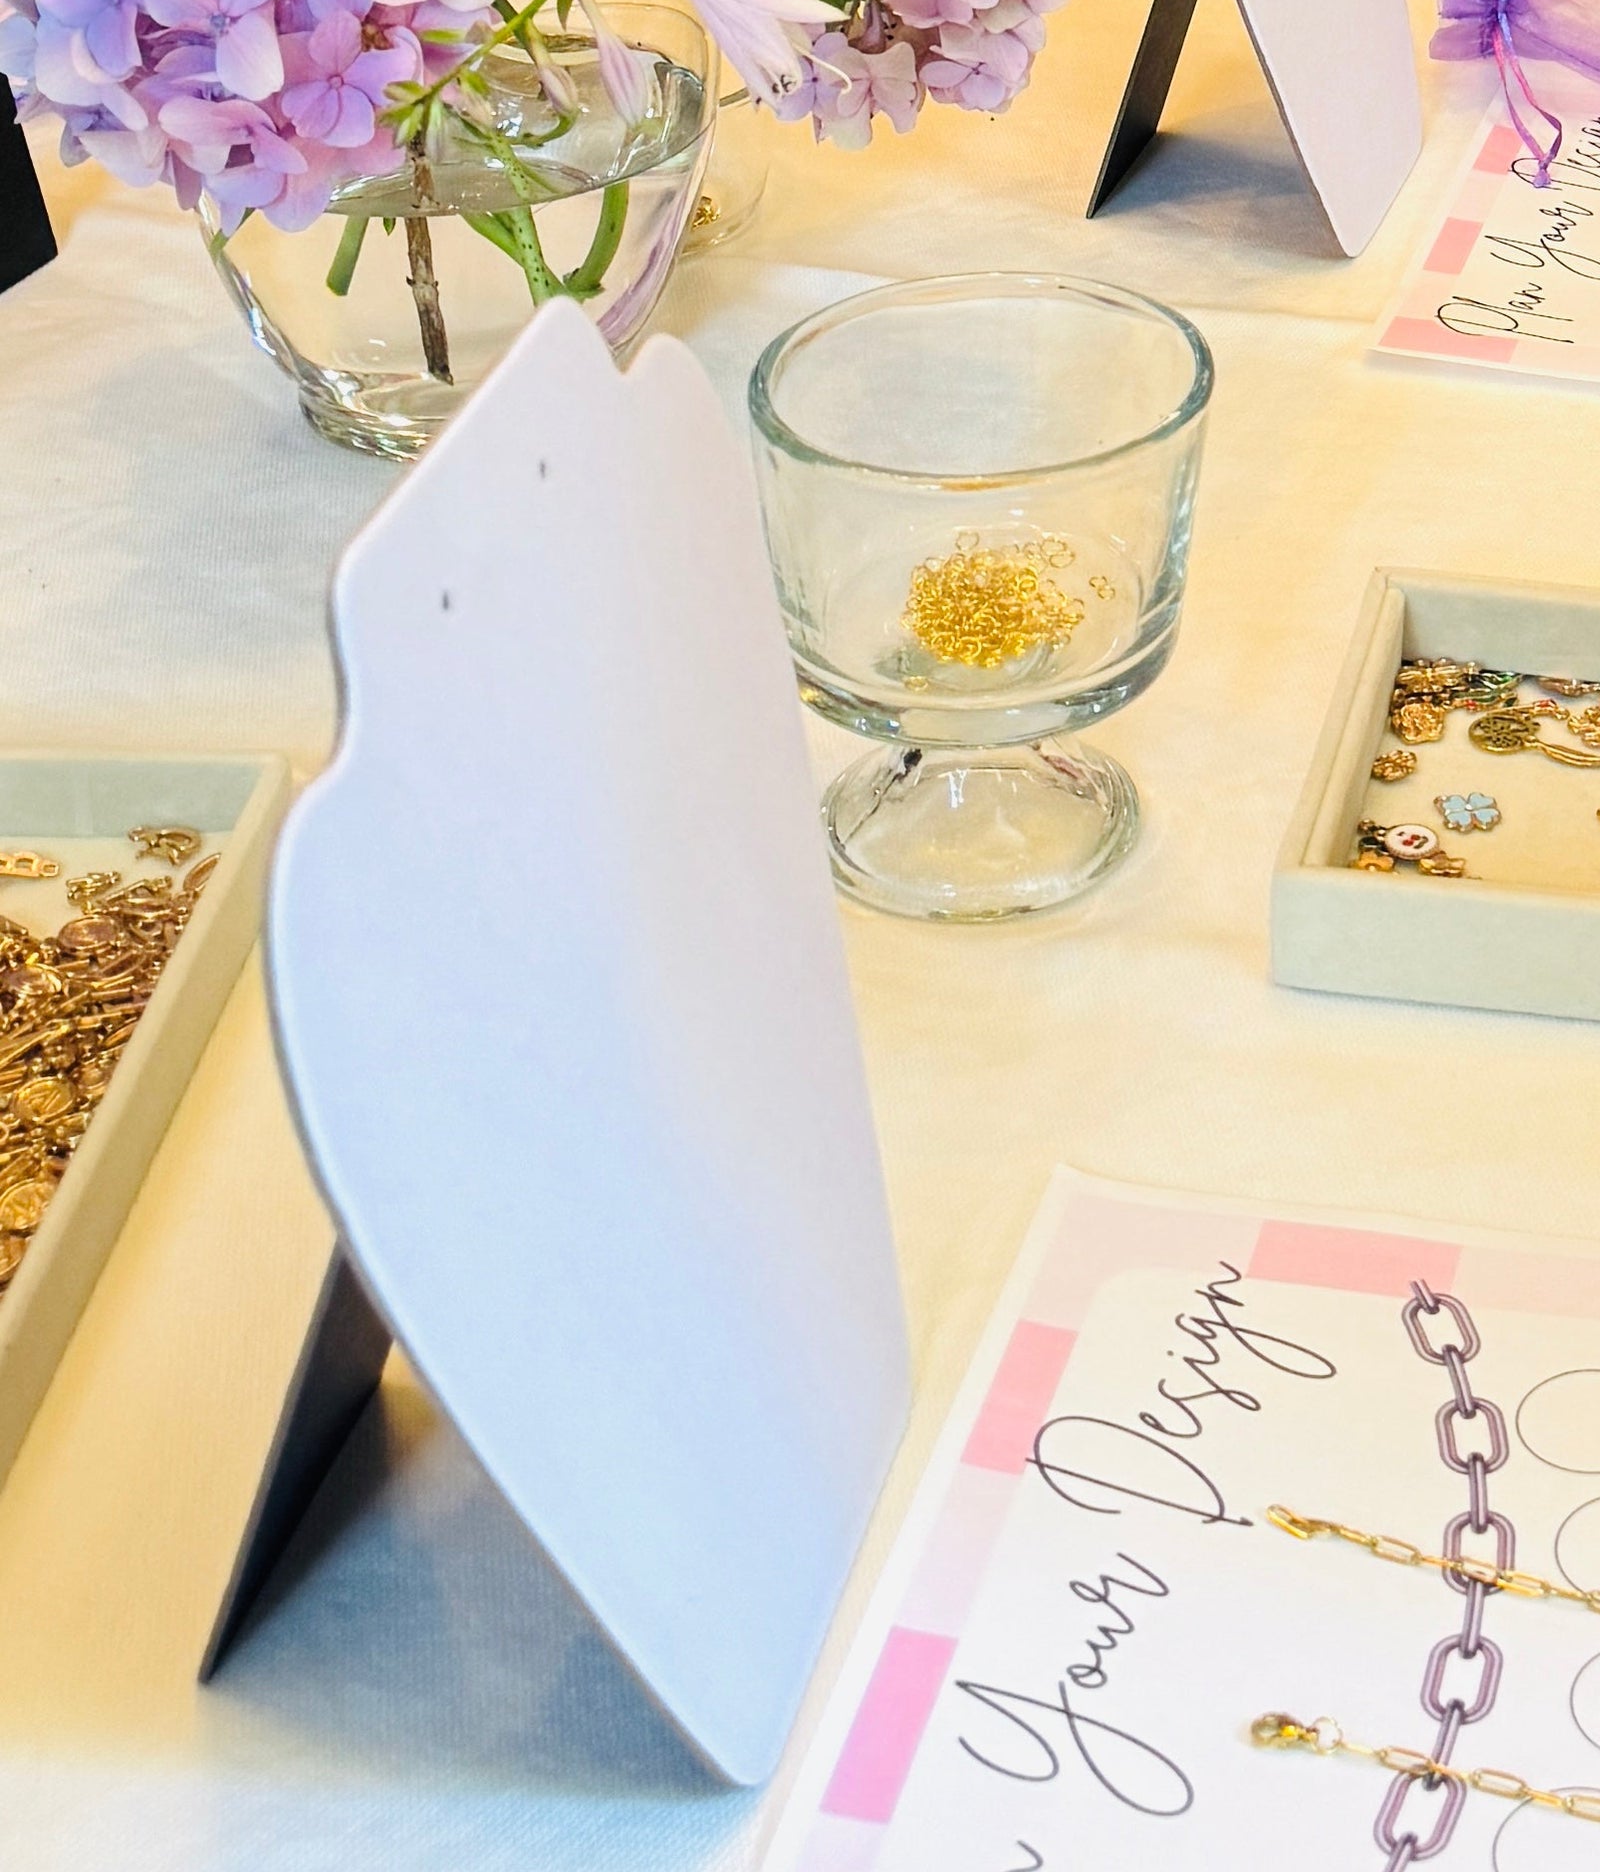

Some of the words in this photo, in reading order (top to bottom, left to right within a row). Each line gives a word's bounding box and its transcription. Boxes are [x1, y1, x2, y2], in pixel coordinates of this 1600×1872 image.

[1434, 282, 1575, 344] Plan
[1024, 1260, 1337, 1527] Design
[954, 1551, 1194, 1817] Your
